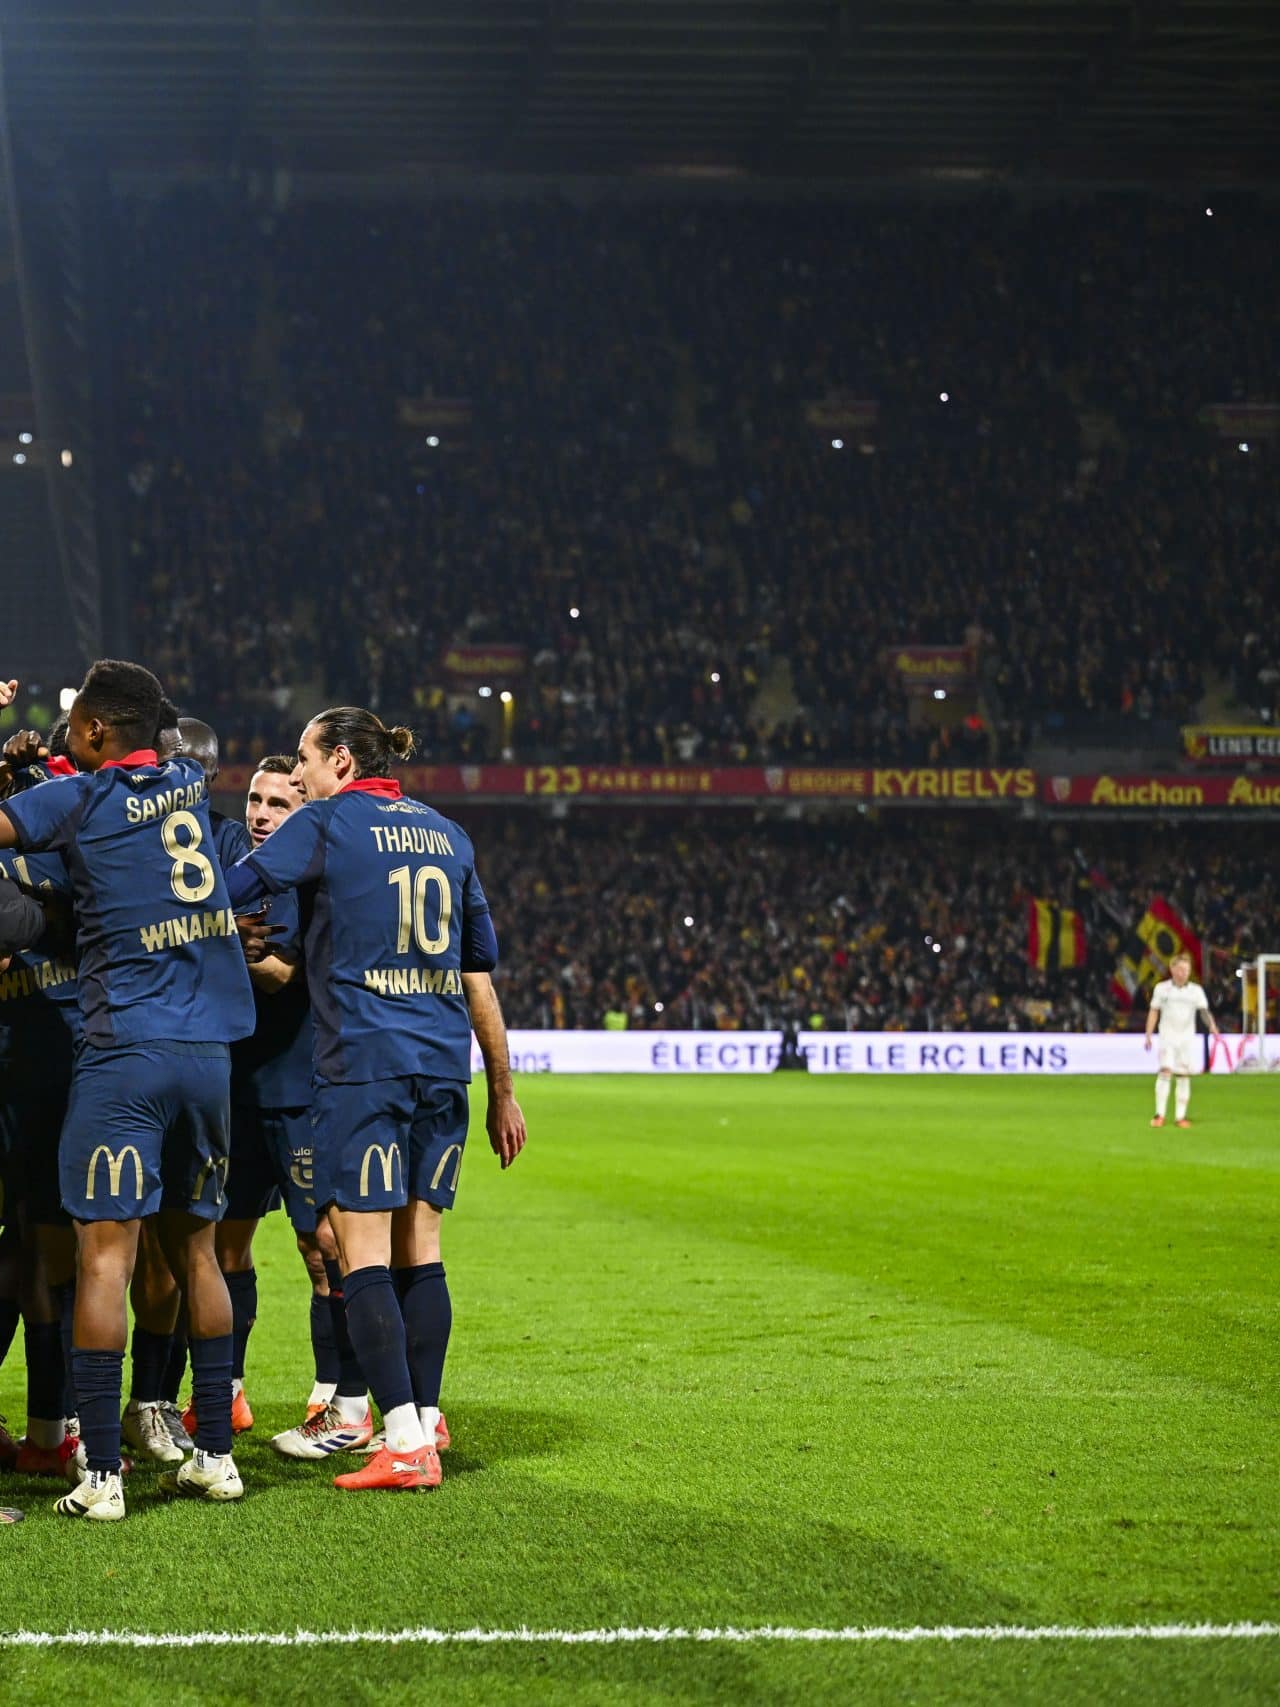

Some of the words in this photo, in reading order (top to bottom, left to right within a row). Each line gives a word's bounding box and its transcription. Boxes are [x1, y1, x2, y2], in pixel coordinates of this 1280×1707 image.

[1208, 735, 1252, 756] LENS
[524, 766, 583, 795] 123
[872, 768, 1036, 798] KYRIELYS
[1091, 775, 1203, 806] Auchan
[160, 810, 215, 903] 8
[370, 826, 455, 857] THAUVIN
[388, 865, 452, 955] 10
[140, 907, 239, 953] WINAMA
[867, 1045, 905, 1068] LE
[921, 1044, 965, 1069] RC
[979, 1044, 1068, 1069] LENS
